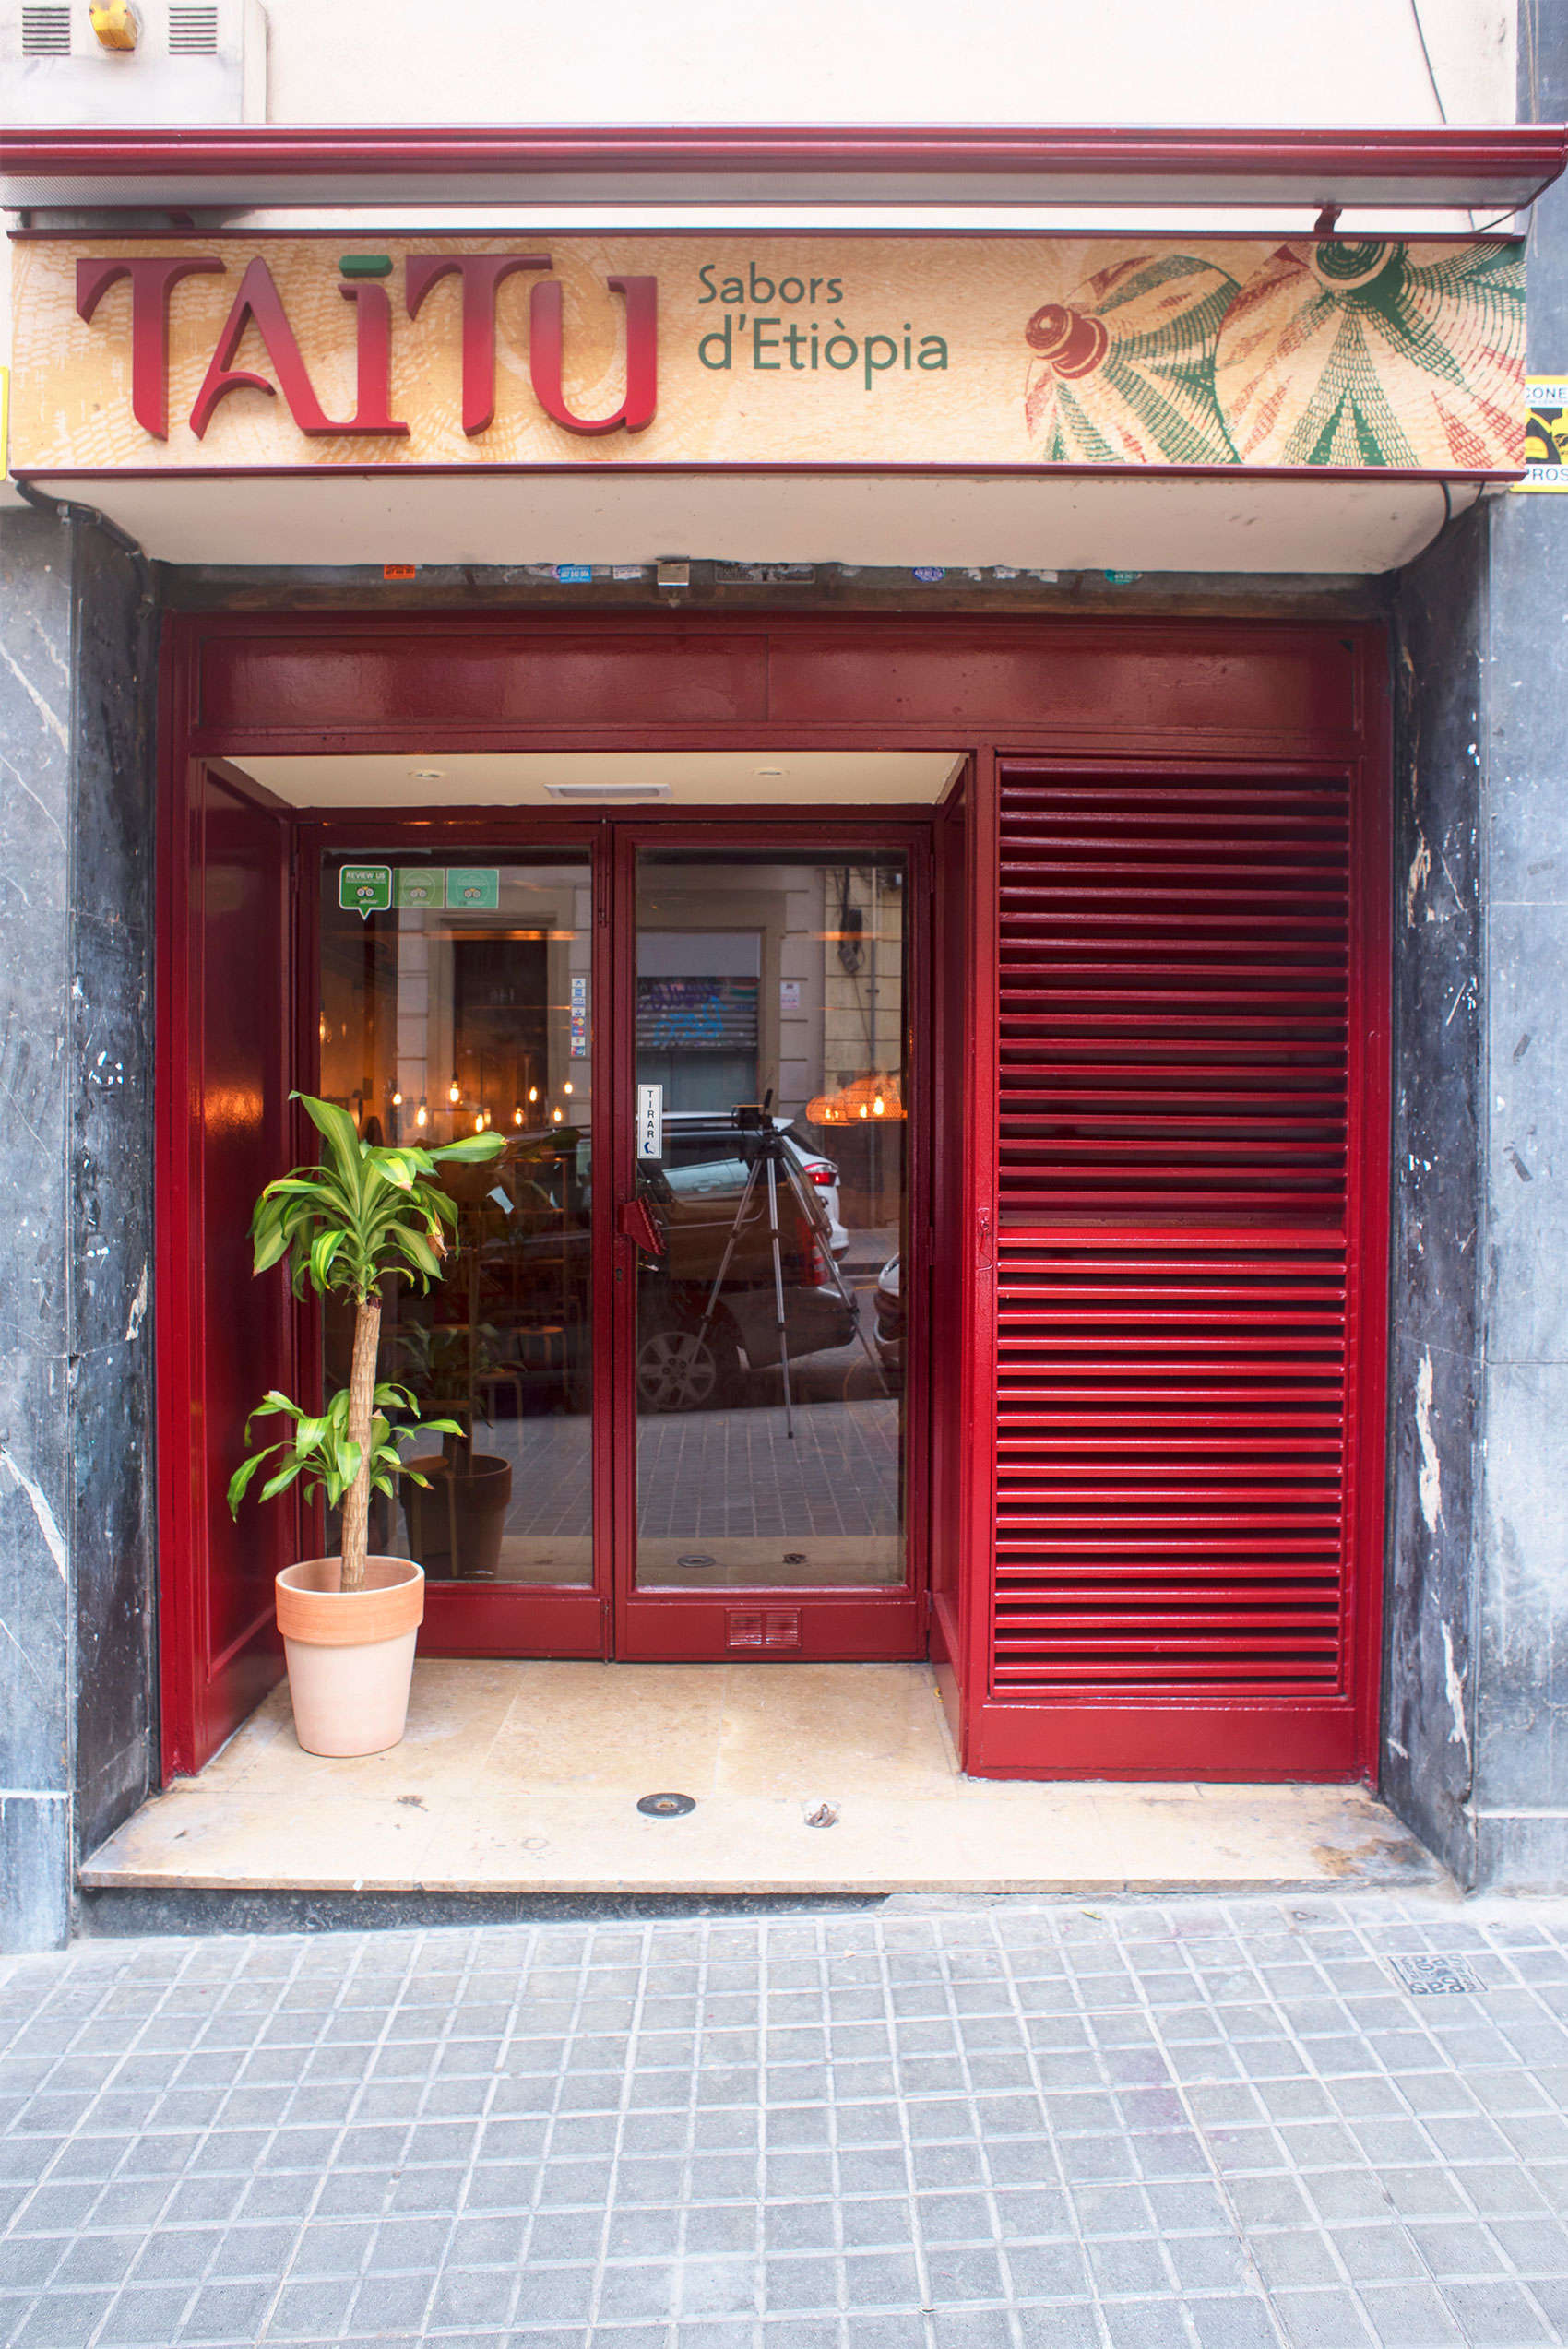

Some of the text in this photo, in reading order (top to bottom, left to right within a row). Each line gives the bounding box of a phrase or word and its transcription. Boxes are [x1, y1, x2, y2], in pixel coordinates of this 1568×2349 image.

[698, 261, 843, 304] Sabors
[698, 314, 948, 391] d'Etiòpia
[346, 871, 386, 879] REVIEW US
